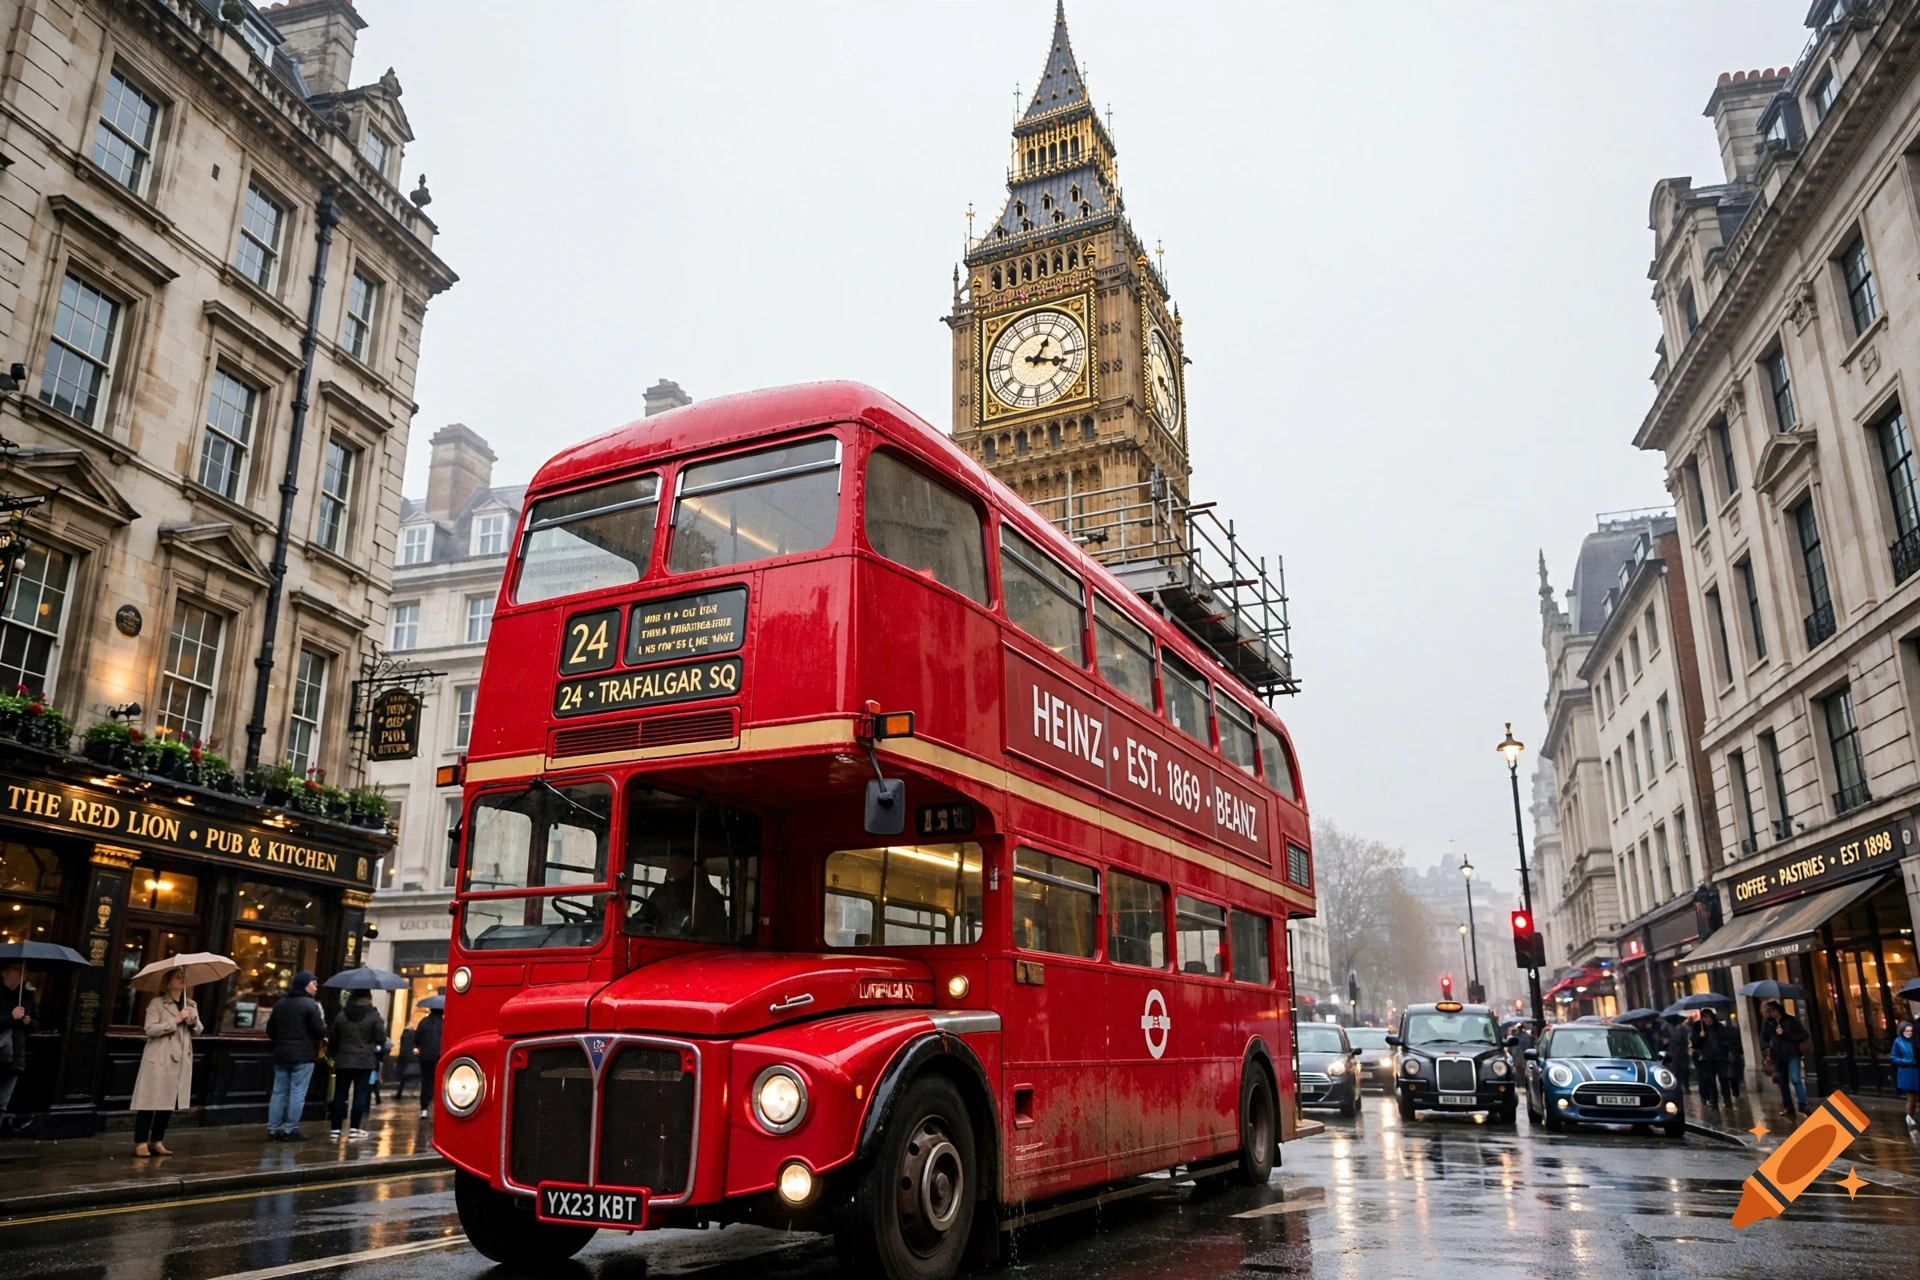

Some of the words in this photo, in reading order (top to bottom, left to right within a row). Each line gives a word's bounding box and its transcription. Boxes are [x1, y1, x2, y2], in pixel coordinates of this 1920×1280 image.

[569, 620, 608, 664] 24
[560, 685, 582, 710] 24
[599, 668, 702, 703] TRAFALGAR
[709, 664, 736, 690] SQ
[1032, 684, 1104, 769] HEINZ
[1126, 737, 1162, 796] EST.
[1167, 760, 1200, 813] 1869
[1215, 786, 1258, 842] BEANZ
[7, 785, 62, 818] THE
[69, 798, 120, 829] RED
[127, 810, 181, 842] LION
[205, 827, 243, 854] PUB
[248, 837, 262, 857] &
[268, 841, 338, 873] KITCHEN
[1735, 875, 1768, 901] COFFEE
[1778, 855, 1826, 886] PASTRIES
[1839, 841, 1860, 866] EST
[1863, 831, 1892, 858] 1898
[547, 1191, 594, 1217] YX23
[599, 1194, 637, 1221] KBT
